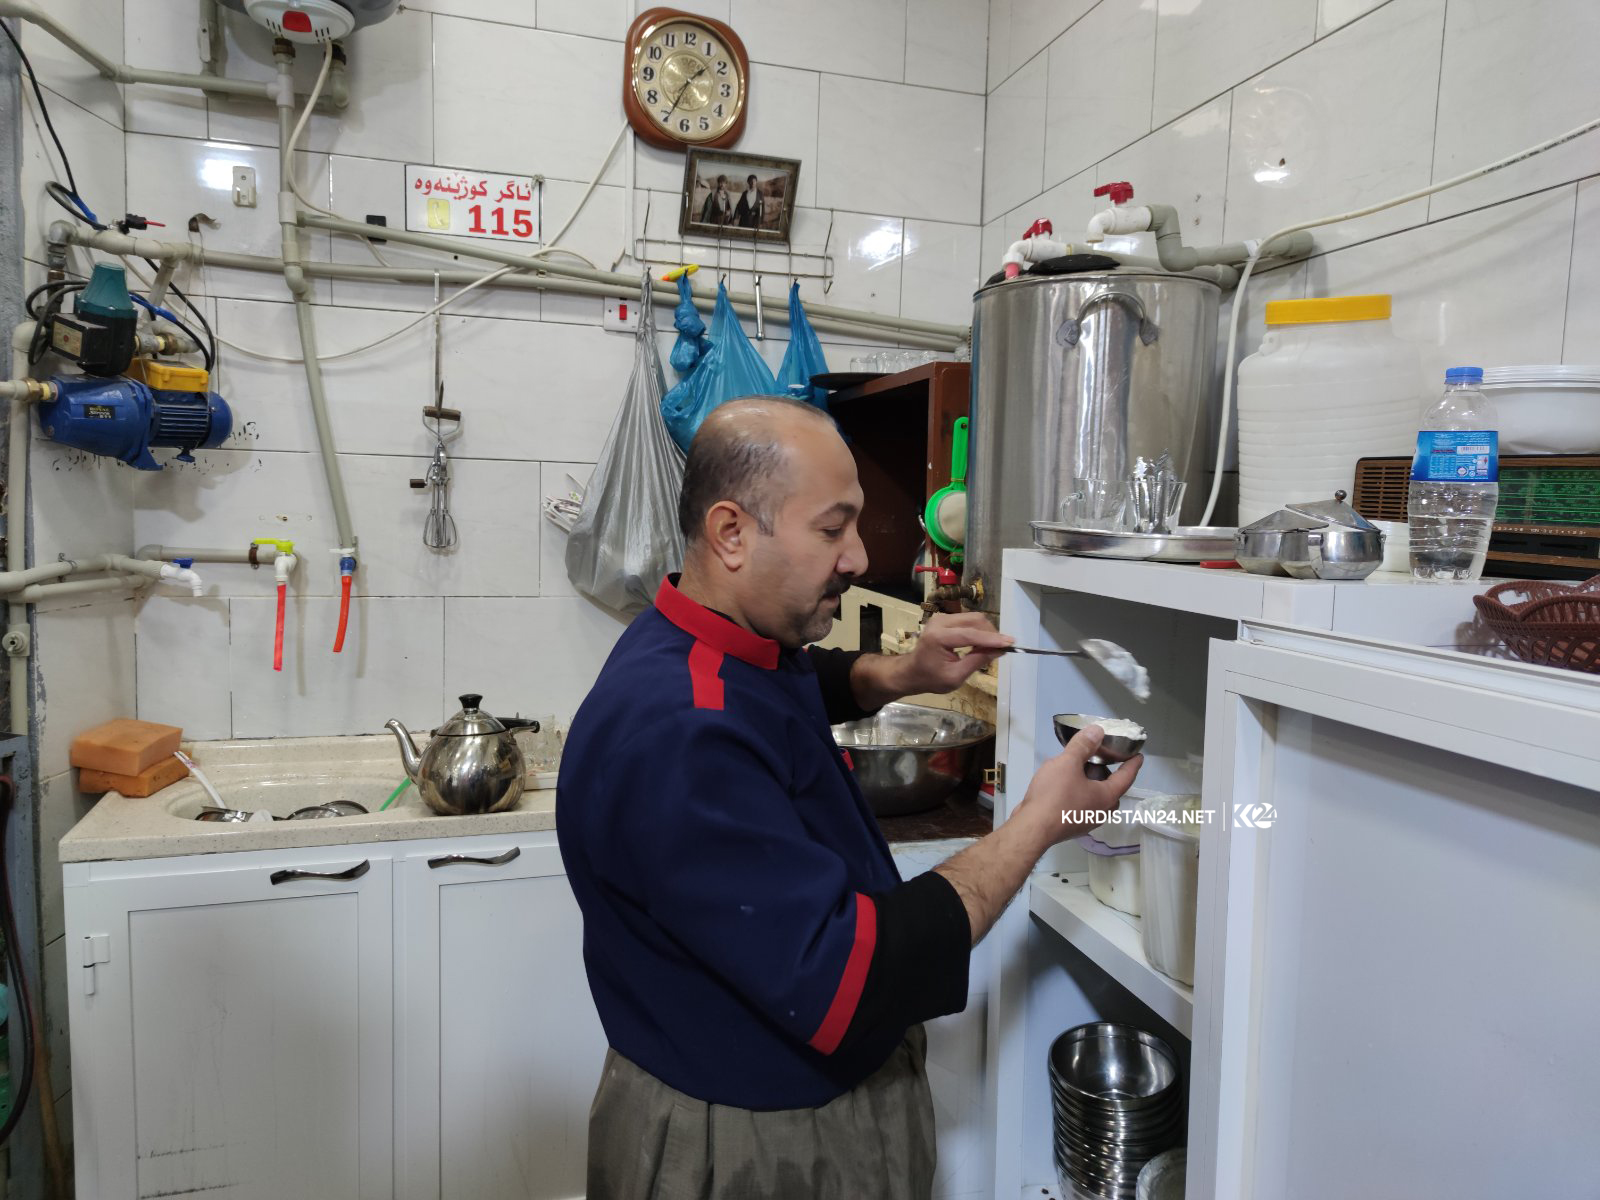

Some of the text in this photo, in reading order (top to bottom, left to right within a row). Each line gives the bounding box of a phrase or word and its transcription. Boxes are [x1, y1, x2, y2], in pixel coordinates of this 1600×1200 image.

[665, 33, 676, 48] 11
[684, 32, 697, 46] 12
[650, 46, 662, 60] 10
[706, 42, 712, 56] 1
[643, 66, 654, 81] 9
[717, 61, 728, 75] 2
[647, 90, 658, 104] 8
[720, 84, 731, 98] 3
[661, 110, 671, 123] 7
[713, 104, 724, 117] 4
[679, 119, 690, 132] 6
[699, 117, 709, 131] 5
[494, 180, 532, 203] ئاگر
[468, 204, 533, 238] 115
